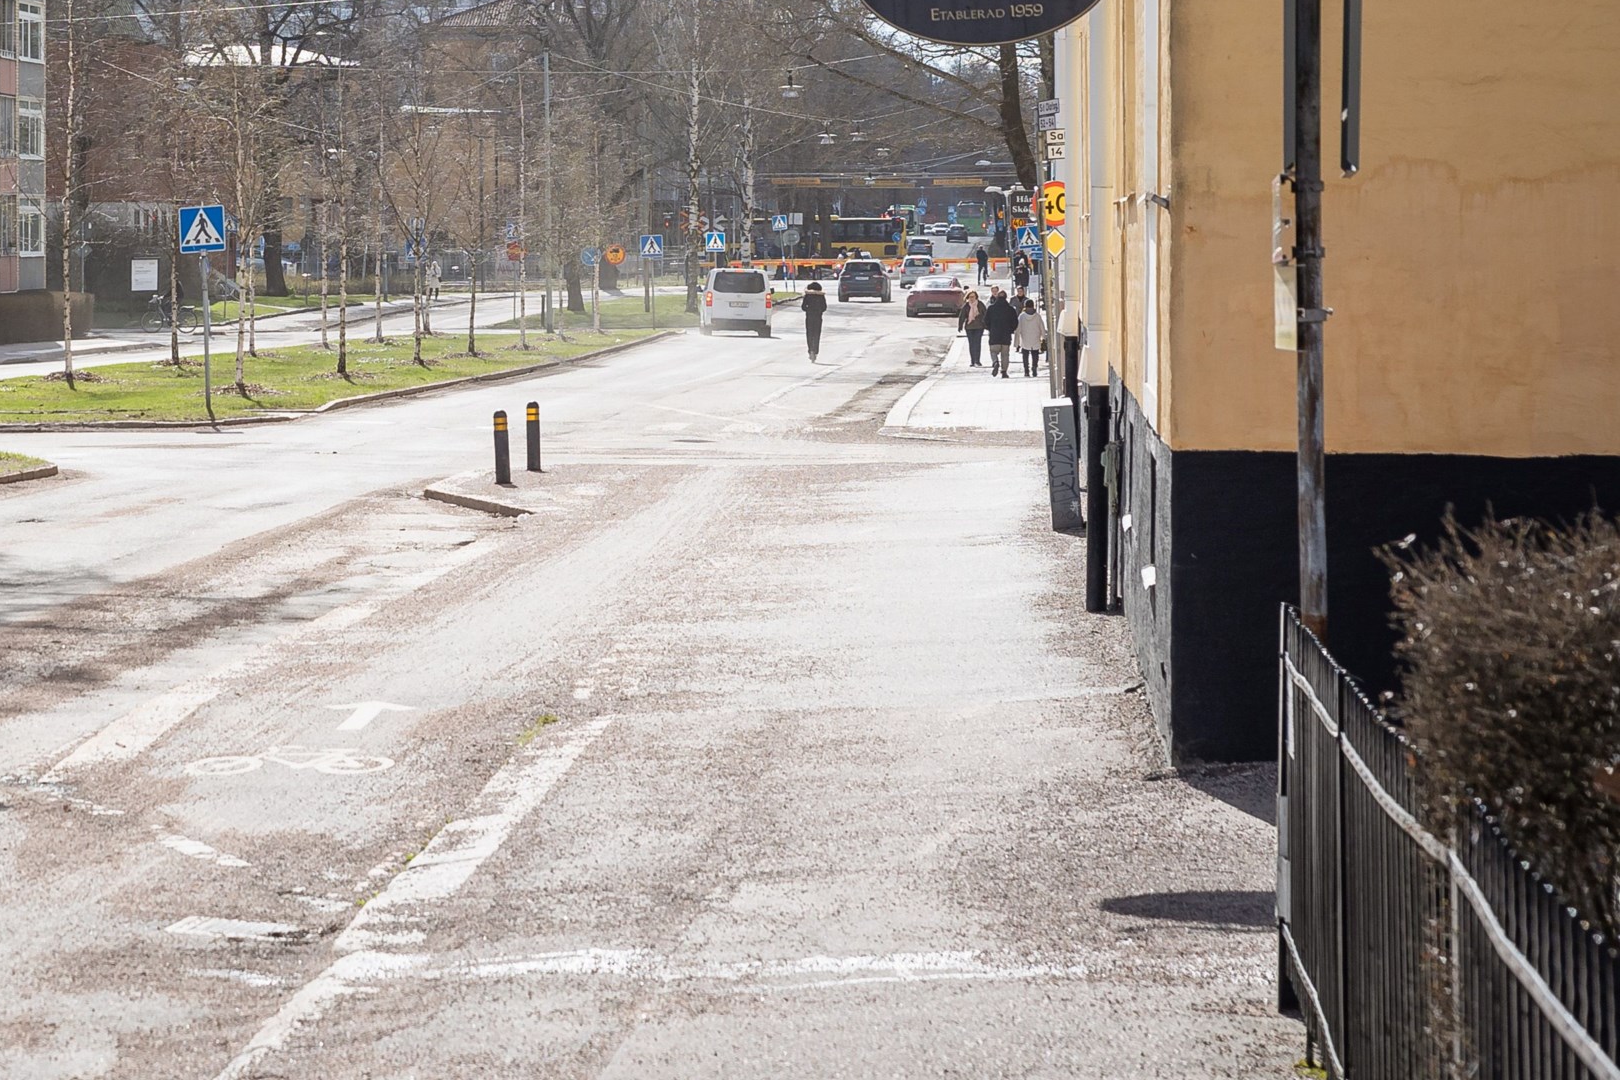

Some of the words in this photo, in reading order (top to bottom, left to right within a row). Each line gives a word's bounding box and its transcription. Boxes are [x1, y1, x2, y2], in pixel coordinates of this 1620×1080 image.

[1010, 3, 1044, 18] 1959
[1051, 147, 1063, 156] 14
[1044, 193, 1065, 214] 40
